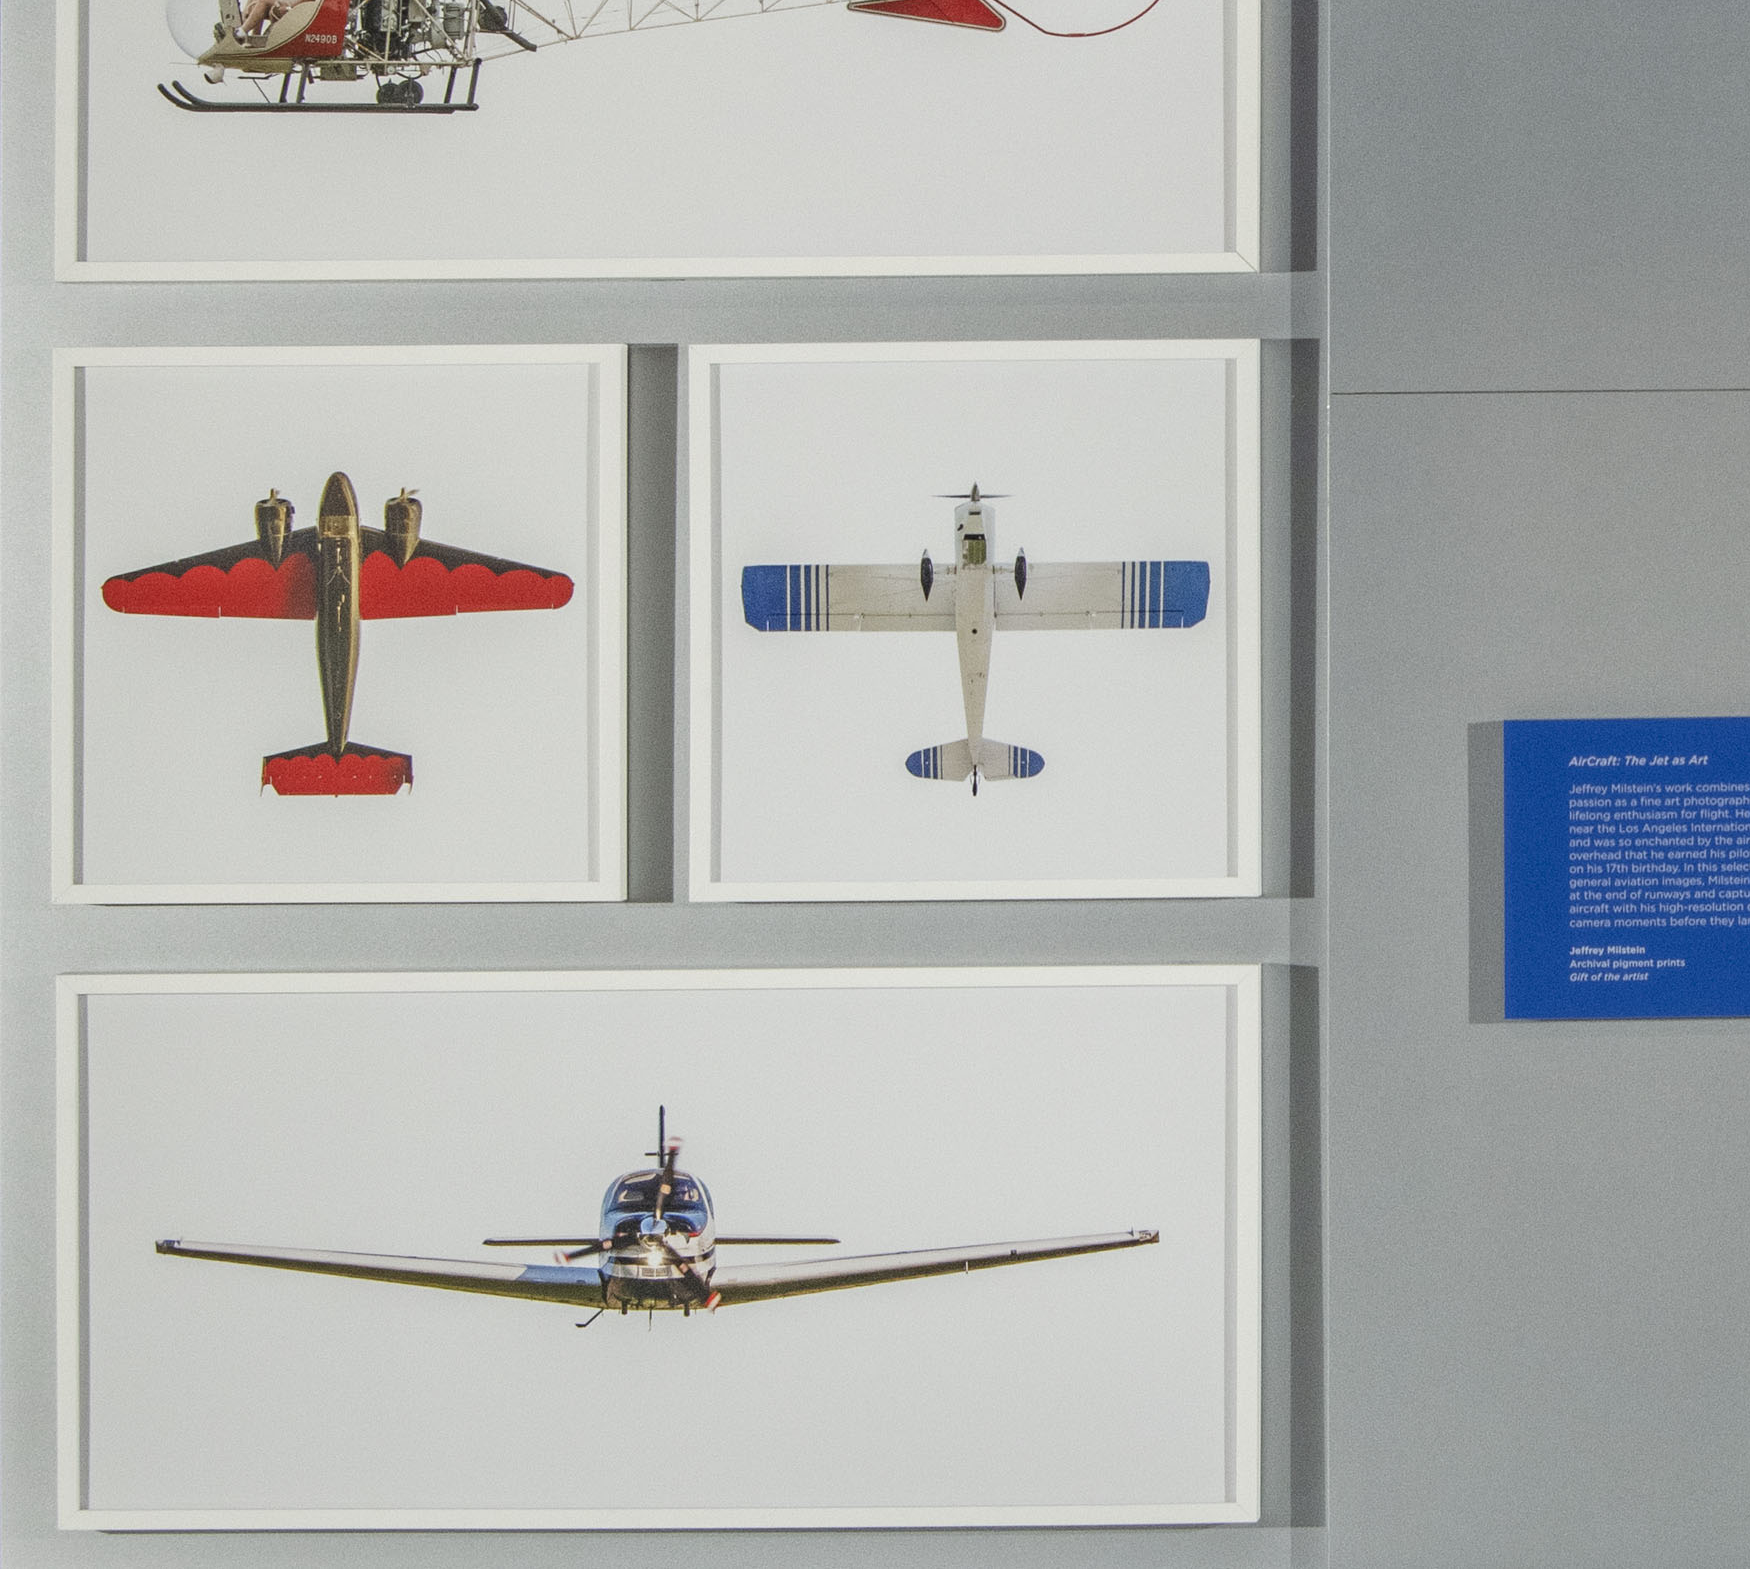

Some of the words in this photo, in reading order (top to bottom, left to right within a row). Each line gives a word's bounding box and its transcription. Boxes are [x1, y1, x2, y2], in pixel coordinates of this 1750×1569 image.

[1568, 755, 1620, 766] AirCraft:
[1625, 755, 1646, 765] The
[1649, 755, 1669, 765] Jet
[1671, 756, 1685, 765] as
[1688, 754, 1708, 765] Art
[1569, 783, 1607, 795] Jeffrey
[1610, 783, 1661, 793] Milstein's
[1664, 783, 1692, 793] work
[1695, 782, 1750, 792] combines
[1569, 810, 1611, 822] lifelong
[1613, 810, 1677, 820] enthusiasm
[1680, 808, 1696, 819] for
[1699, 808, 1732, 820] flight.
[1735, 809, 1750, 818] He
[1568, 850, 1621, 860] overhead
[1624, 850, 1647, 859] that
[1650, 849, 1664, 859] he
[1667, 849, 1707, 859] earned
[1709, 848, 1726, 858] his
[1569, 877, 1611, 888] general
[1613, 877, 1658, 886] aviation
[1661, 877, 1704, 887] images,
[1707, 875, 1750, 885] Milstein
[1569, 903, 1609, 913] aircraft
[1612, 903, 1637, 913] with
[1639, 903, 1656, 912] his
[1658, 902, 1744, 913] high-resolution
[1569, 945, 1604, 956] Jeffrey
[1606, 945, 1645, 954] Milstein
[1569, 959, 1610, 968] Archival
[1612, 959, 1654, 969] pigment
[1656, 958, 1685, 968] prints
[1569, 972, 1588, 981] Gift
[1590, 972, 1602, 981] of
[1603, 972, 1620, 981] the
[1622, 972, 1648, 981] artist
